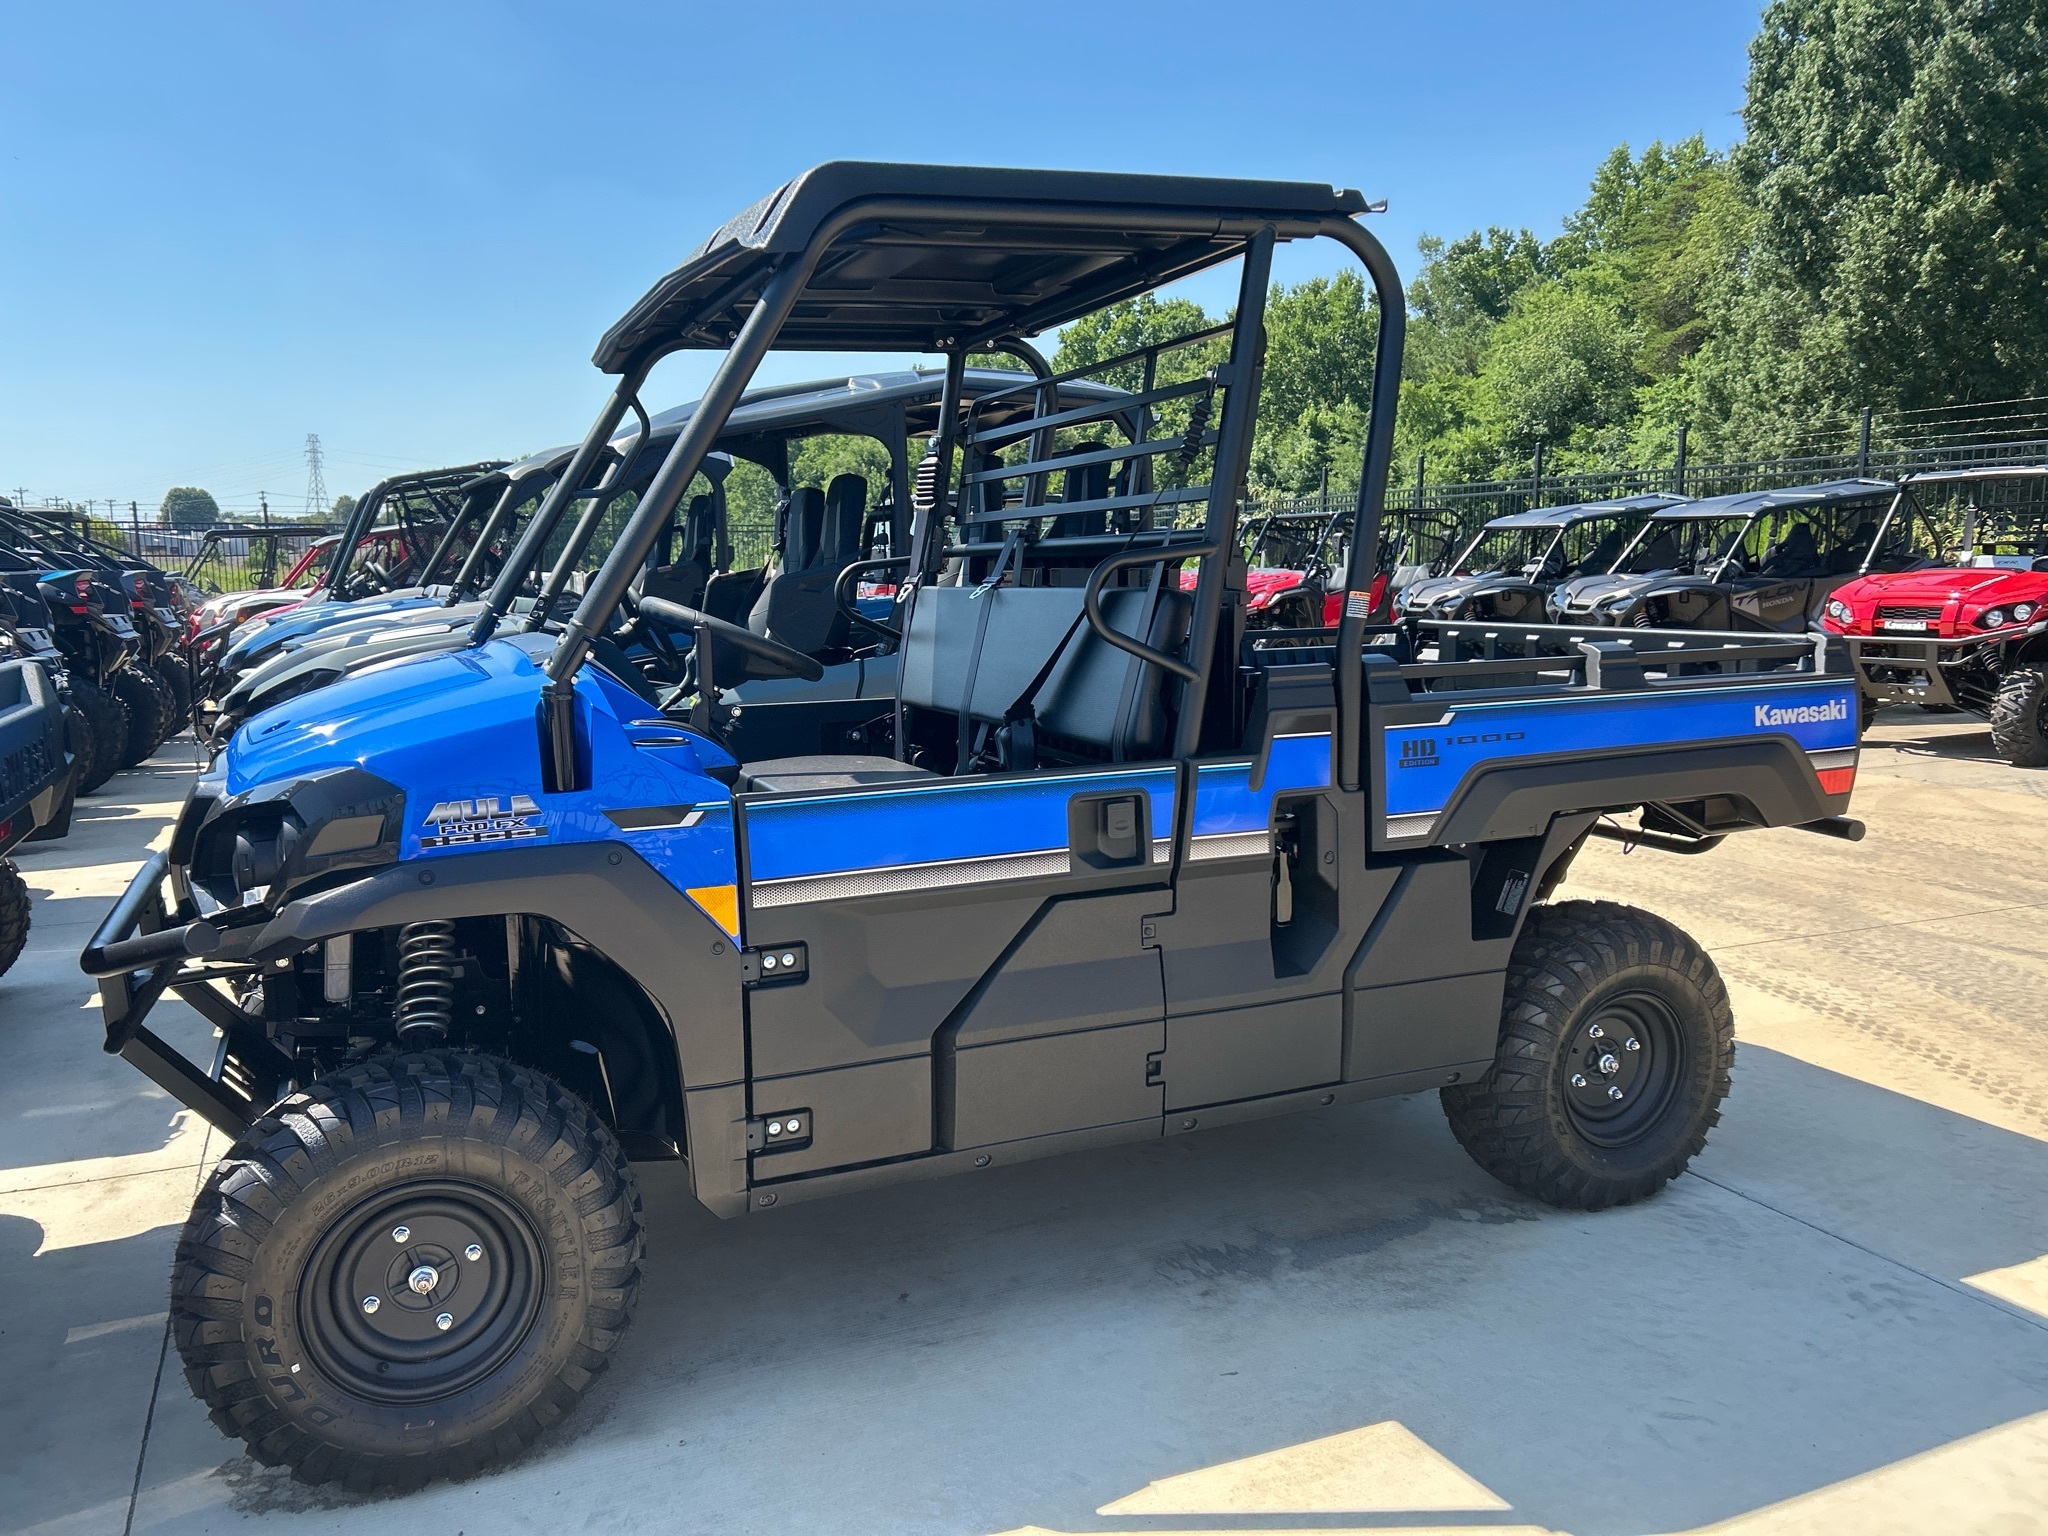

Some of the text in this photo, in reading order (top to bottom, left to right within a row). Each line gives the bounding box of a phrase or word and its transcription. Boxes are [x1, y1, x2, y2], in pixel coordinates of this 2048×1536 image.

[1762, 596, 1794, 609] HONDA
[1884, 620, 1927, 630] Kawasaki
[1755, 699, 1847, 727] Kawasaki
[1445, 731, 1525, 745] 1000
[1402, 739, 1436, 758] HD
[1403, 758, 1436, 767] EDITION
[423, 795, 544, 826] MULE
[433, 828, 537, 846] 1000
[253, 1293, 341, 1429] DURO
